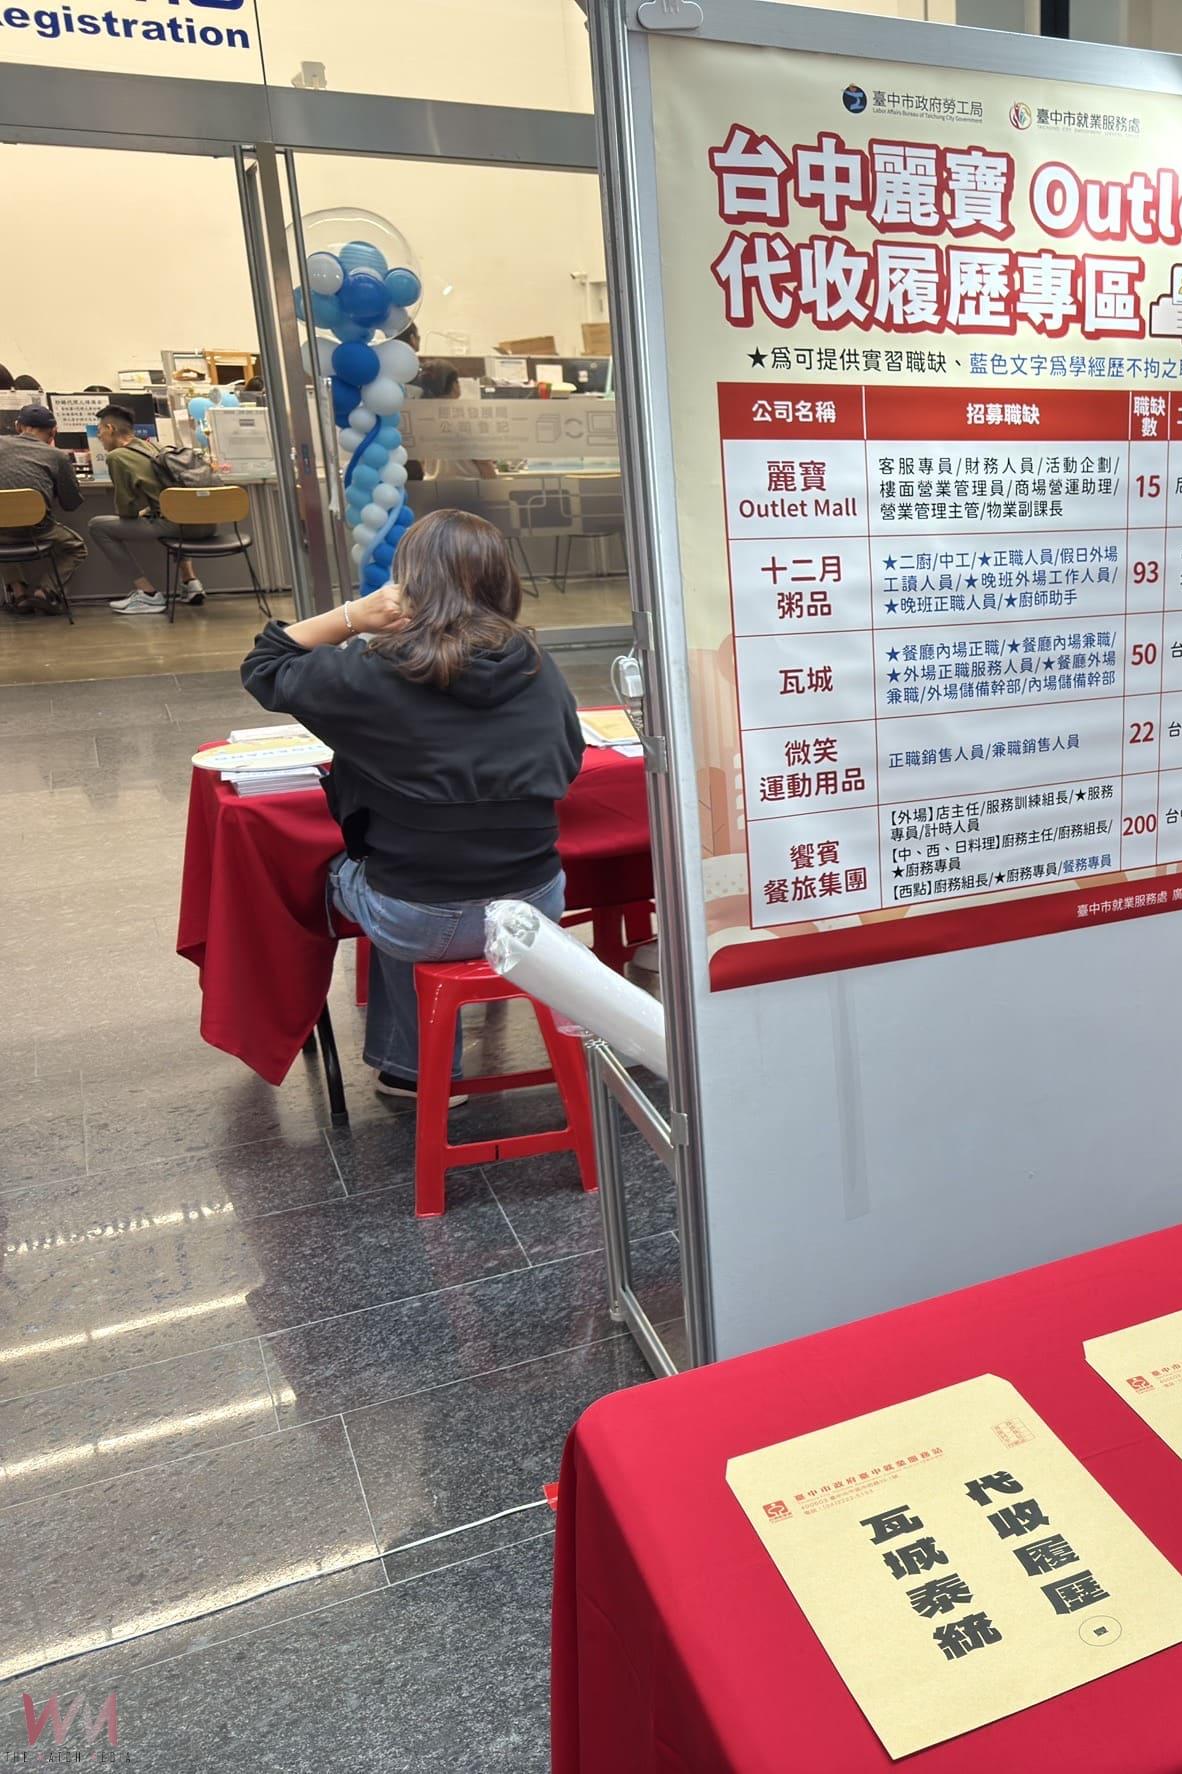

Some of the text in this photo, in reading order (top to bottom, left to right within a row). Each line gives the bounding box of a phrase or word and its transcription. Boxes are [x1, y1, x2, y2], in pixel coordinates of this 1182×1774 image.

[0, 5, 250, 49] egistration
[872, 90, 983, 117] 臺中市政府勞工局
[1036, 108, 1141, 134] 臺中市就業服務處
[710, 125, 1014, 237] 台中麗寶
[712, 233, 1145, 336] 代收履歷專區
[752, 400, 838, 424] 公司名稱
[966, 403, 1041, 426] 招募職缺
[1133, 396, 1166, 418] 職缺
[1141, 417, 1158, 438] 數
[767, 460, 827, 493] 麗寶
[878, 456, 1121, 477] 客服專員/財務人員/活動企劃/
[880, 477, 1121, 499] 樓面營業管理員/商場營運助理/
[1135, 474, 1161, 499] 15
[739, 497, 858, 518] Outlet Mall
[880, 499, 1064, 522] 營業管理主管/物業副課長
[760, 556, 843, 586] 十二月
[1133, 560, 1160, 585] 93
[776, 590, 833, 620] 粥品
[1130, 642, 1158, 667] 50
[779, 665, 835, 696] 瓦城
[1129, 721, 1156, 745] 22
[785, 737, 838, 767] 微笑
[888, 733, 1081, 769] 正職銷售人員/兼職銷售人員
[760, 767, 866, 803] 運動用品
[890, 818, 981, 843] 專員/計時人員
[1122, 813, 1158, 838] 200
[790, 840, 841, 871] 饗賓
[764, 867, 868, 906] 餐旅集團
[1076, 889, 1169, 918] 臺中市就業服務處
[964, 1470, 1111, 1615] 代收履歷
[859, 1504, 1003, 1662] 瓦城泰統
